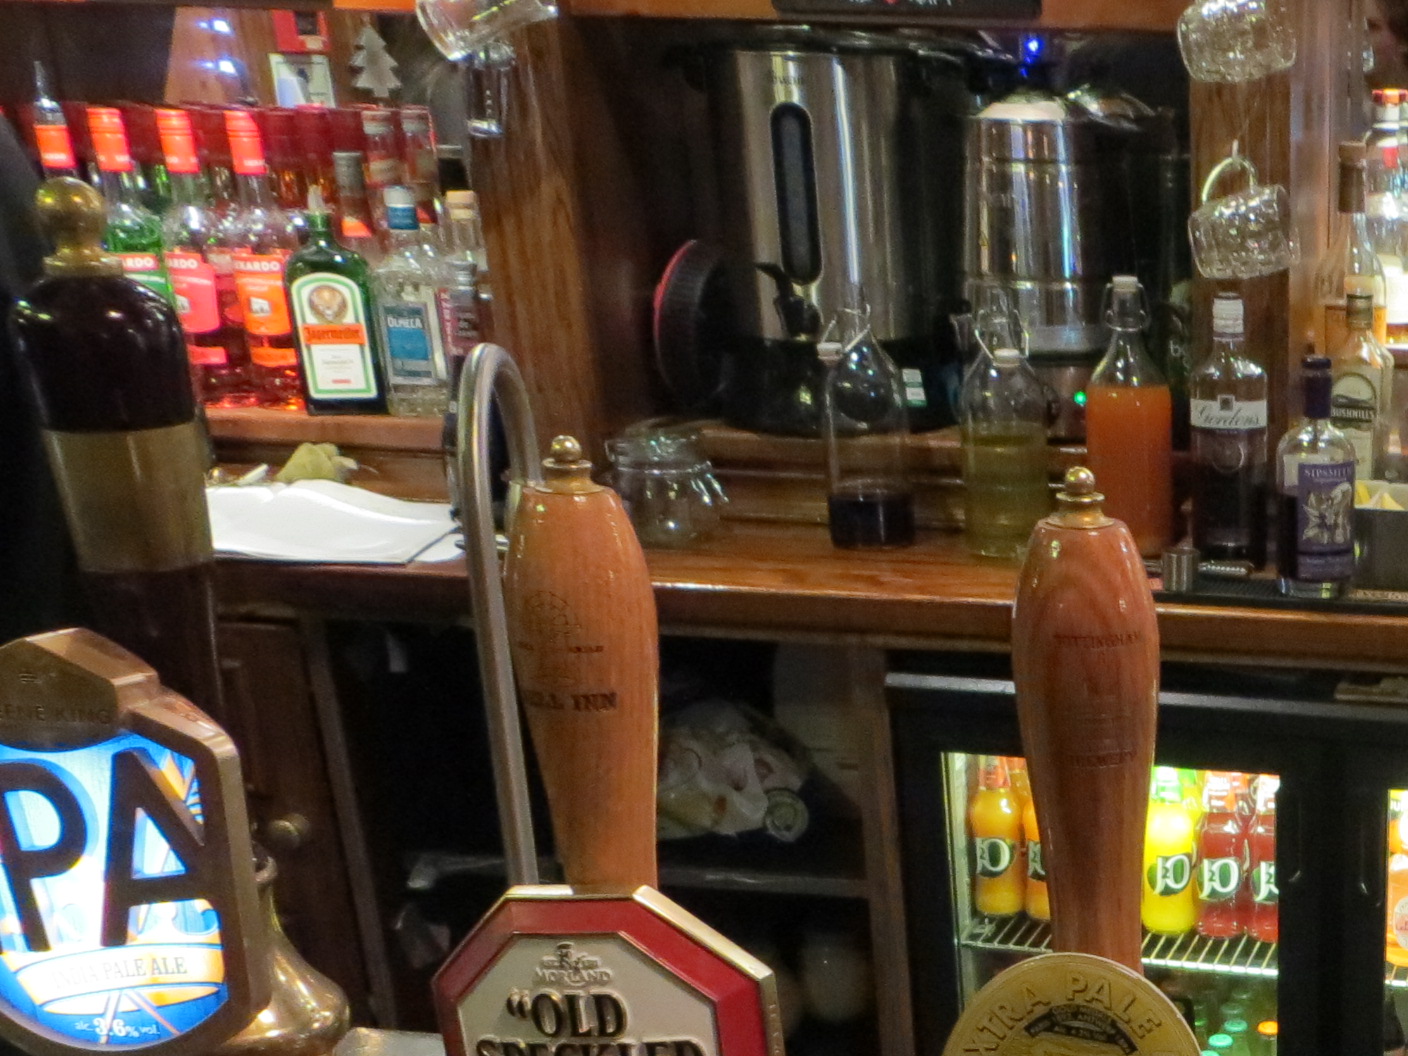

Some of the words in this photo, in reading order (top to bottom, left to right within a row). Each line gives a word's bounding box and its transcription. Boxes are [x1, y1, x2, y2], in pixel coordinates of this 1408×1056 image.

[103, 958, 147, 981] PALE
[151, 956, 188, 976] ALE
[1065, 973, 1163, 1040] PALE
